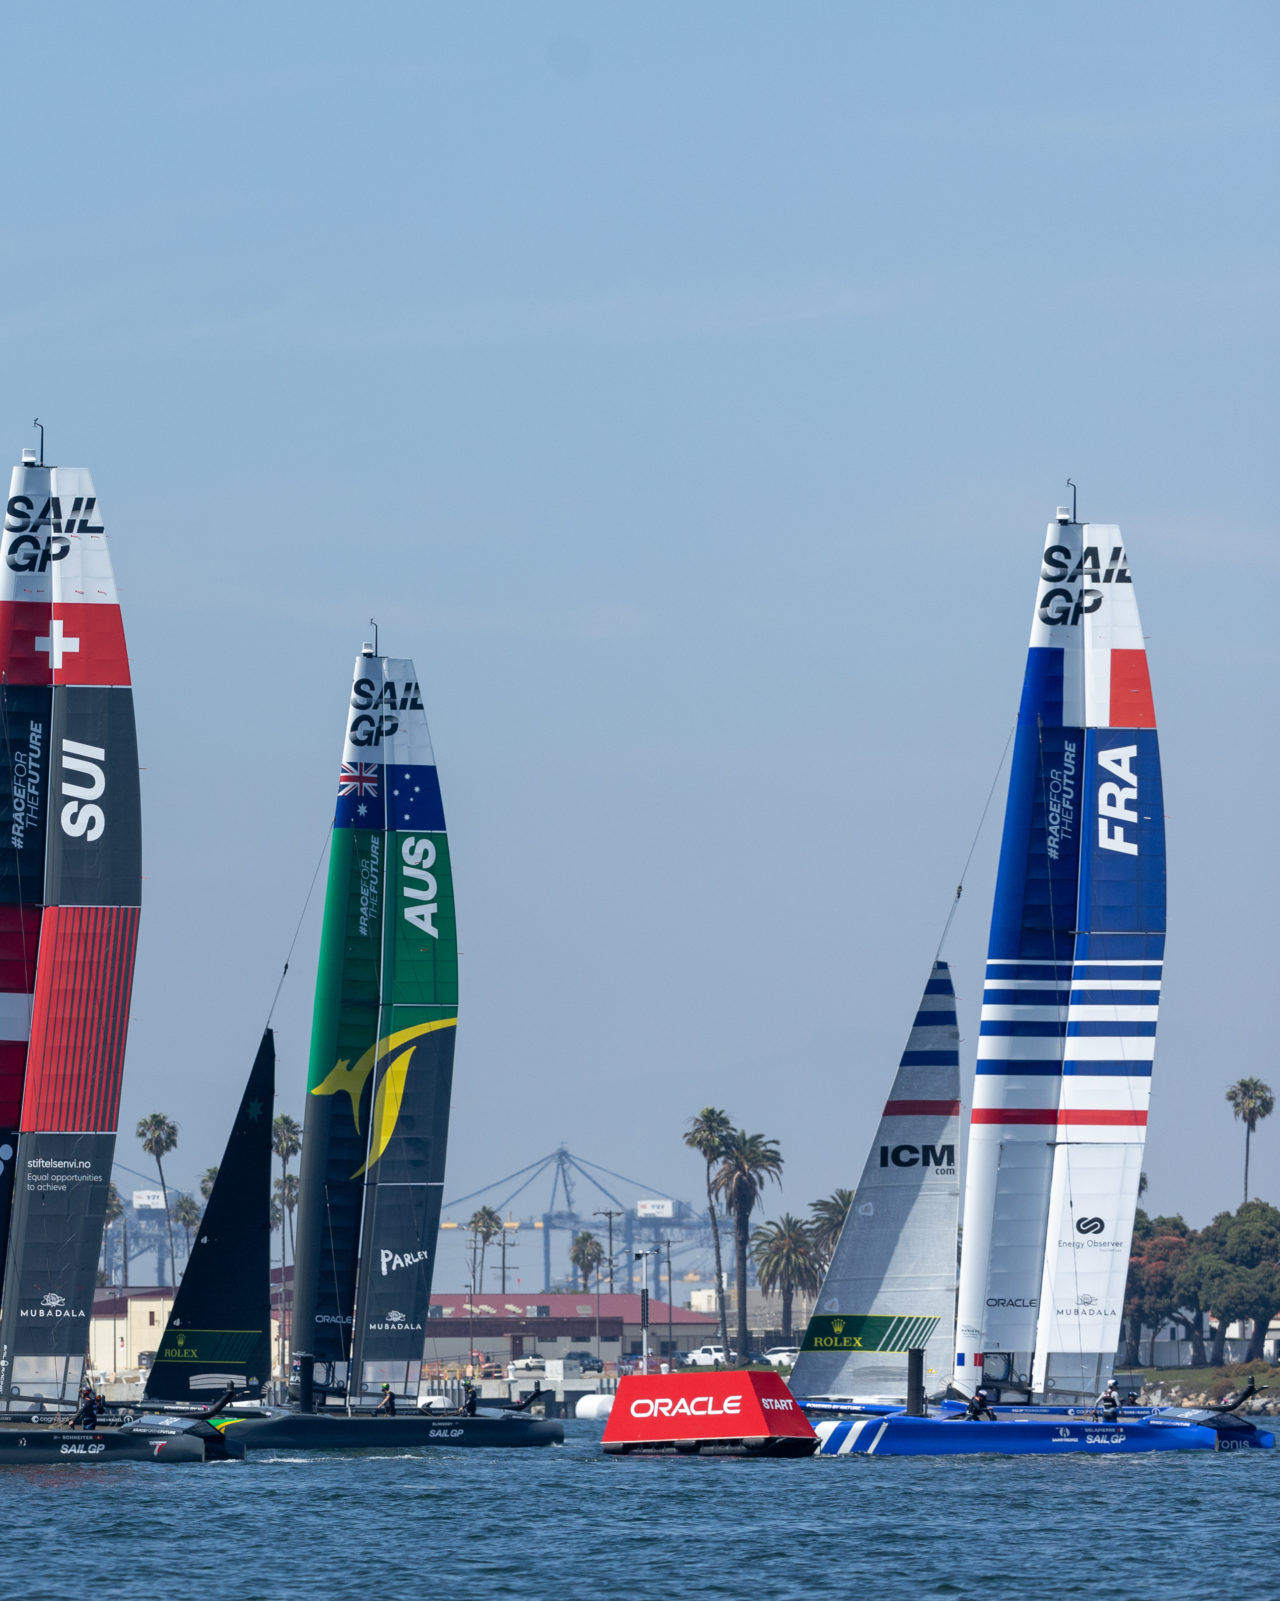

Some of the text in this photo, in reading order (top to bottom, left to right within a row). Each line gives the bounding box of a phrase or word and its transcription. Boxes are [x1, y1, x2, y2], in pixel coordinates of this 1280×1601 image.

[4, 496, 105, 534] SAIL
[6, 535, 70, 573] GP
[1040, 546, 1133, 584] SAIL
[1038, 588, 1105, 626] GP
[350, 678, 425, 711] SAIL
[349, 714, 399, 747] GP
[61, 738, 106, 842] SUI
[1098, 744, 1139, 856] FRA
[401, 836, 439, 939] AUS
[27, 1158, 91, 1169] stiftelsenvi.no
[27, 1173, 103, 1183] Equal opportunities
[27, 1183, 67, 1191] to achieve
[1058, 1239, 1124, 1249] Energy Observer
[986, 1298, 1037, 1308] ORACLE
[20, 1309, 86, 1317] MUBADALA
[315, 1315, 353, 1324] ORACLE
[814, 1337, 863, 1348] ROLEX
[164, 1349, 199, 1359] ROLEX
[630, 1395, 743, 1418] ORACLE
[761, 1397, 794, 1411] START
